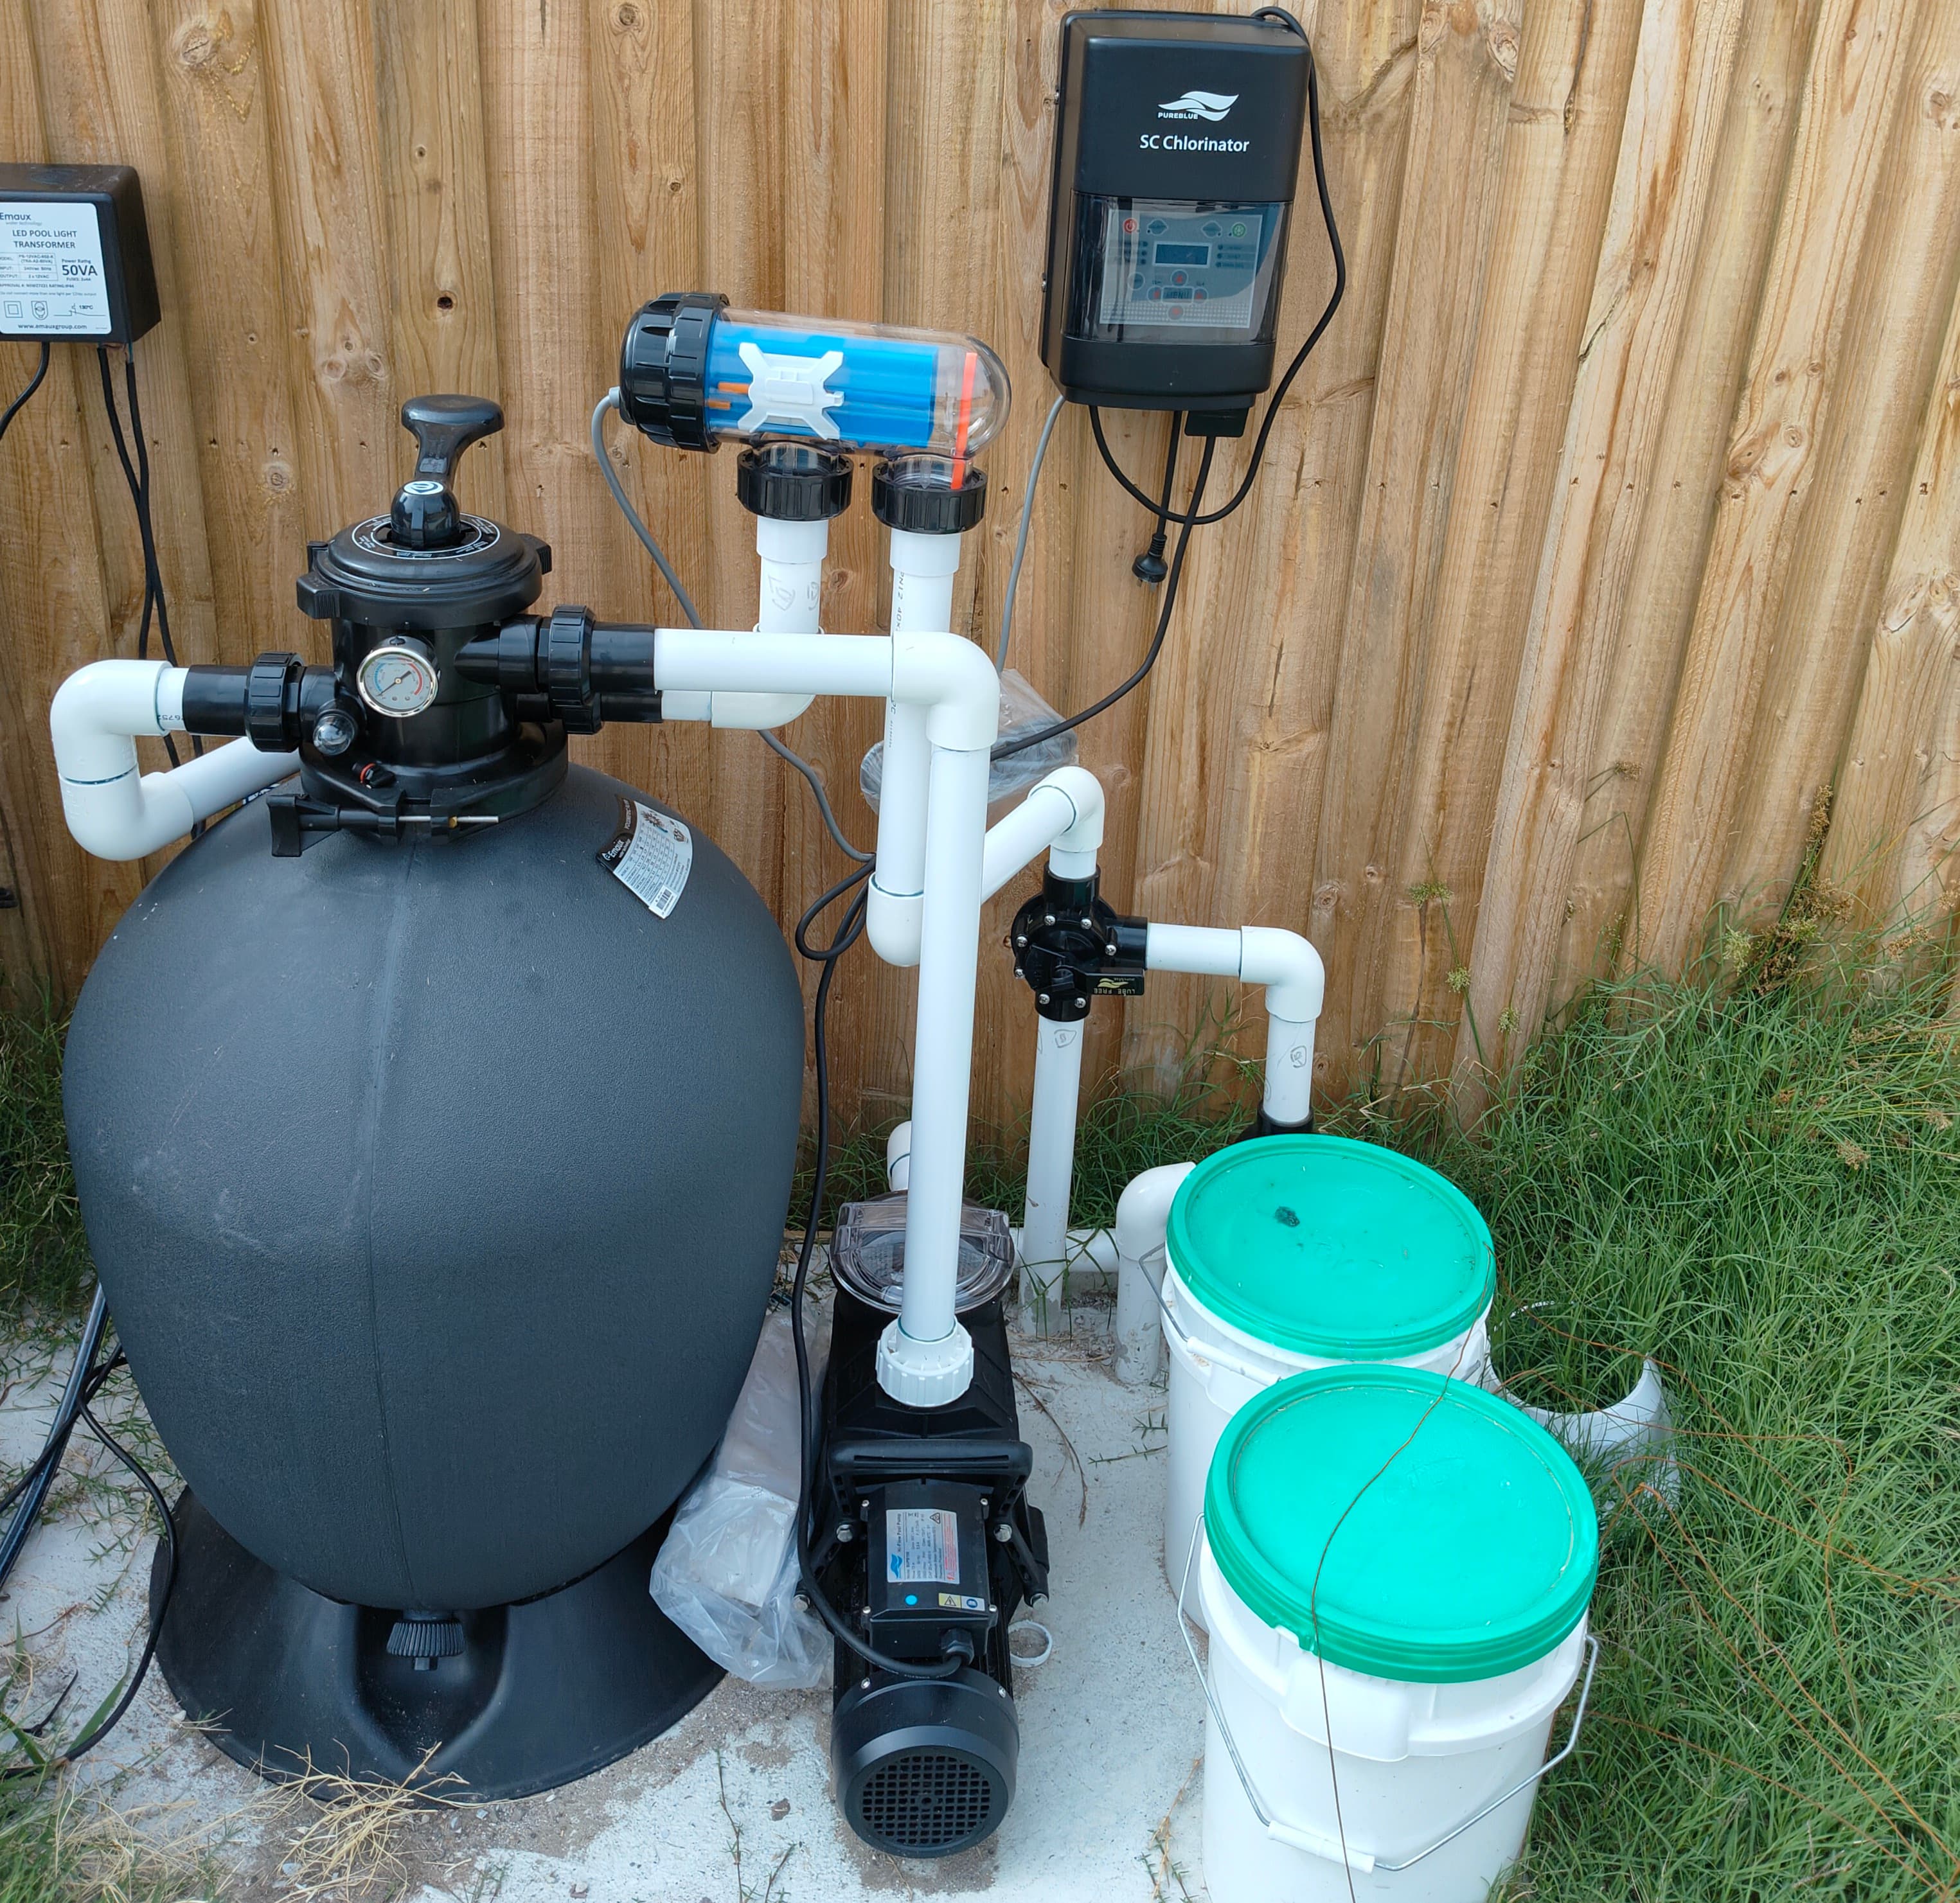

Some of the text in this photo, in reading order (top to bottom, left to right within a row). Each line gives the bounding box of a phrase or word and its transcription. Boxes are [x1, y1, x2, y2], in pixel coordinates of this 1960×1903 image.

[1139, 134, 1250, 152] SC Chlorinator
[0, 212, 31, 220] Emaux
[62, 265, 98, 276] 50VA
